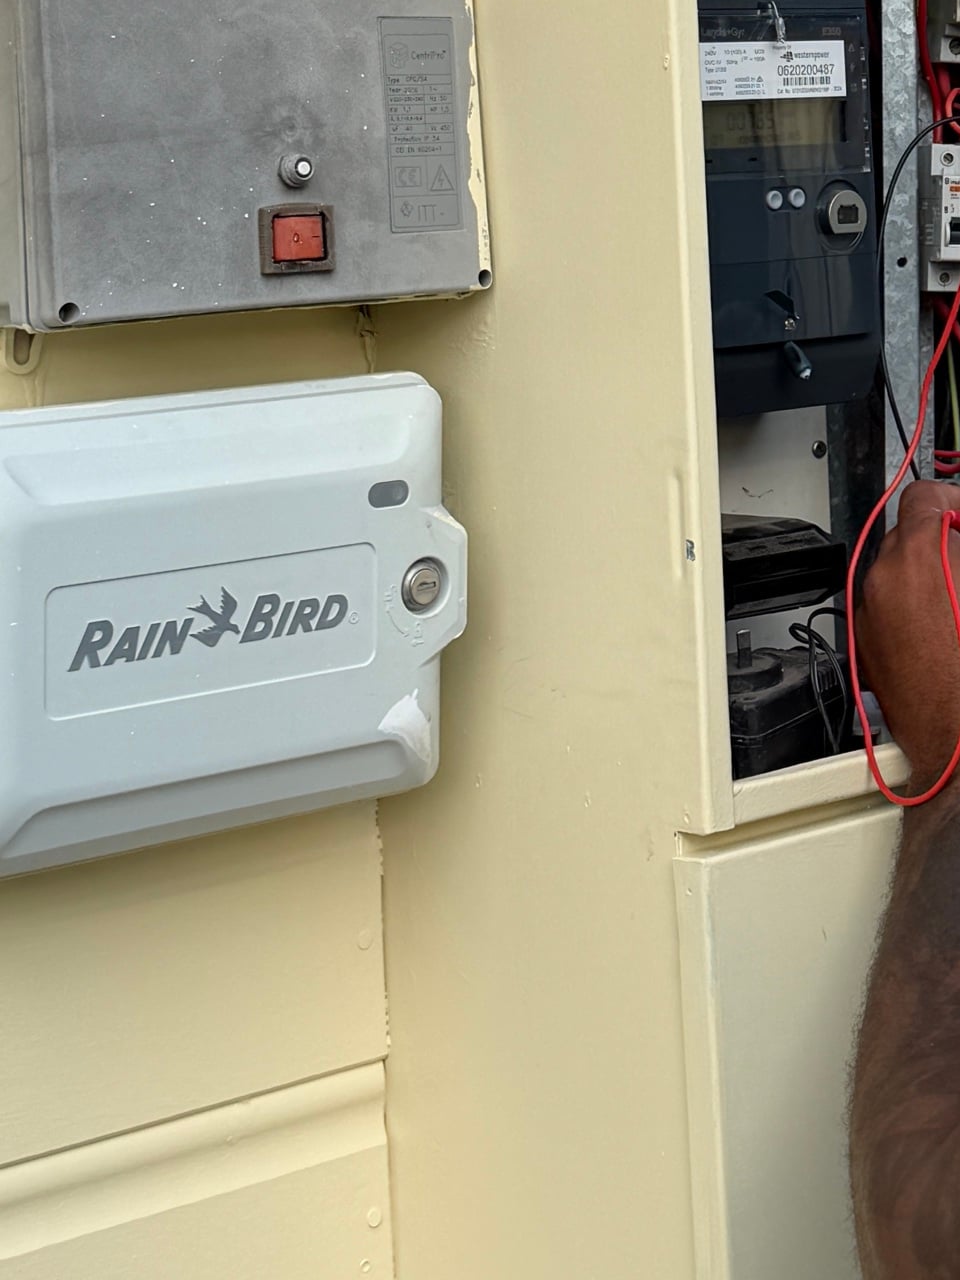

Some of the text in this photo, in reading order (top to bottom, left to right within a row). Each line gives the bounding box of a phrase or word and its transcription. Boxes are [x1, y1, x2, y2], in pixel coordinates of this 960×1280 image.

[777, 64, 835, 76] 0620200487
[67, 618, 194, 672] RAIN
[239, 593, 349, 644] BIRD
